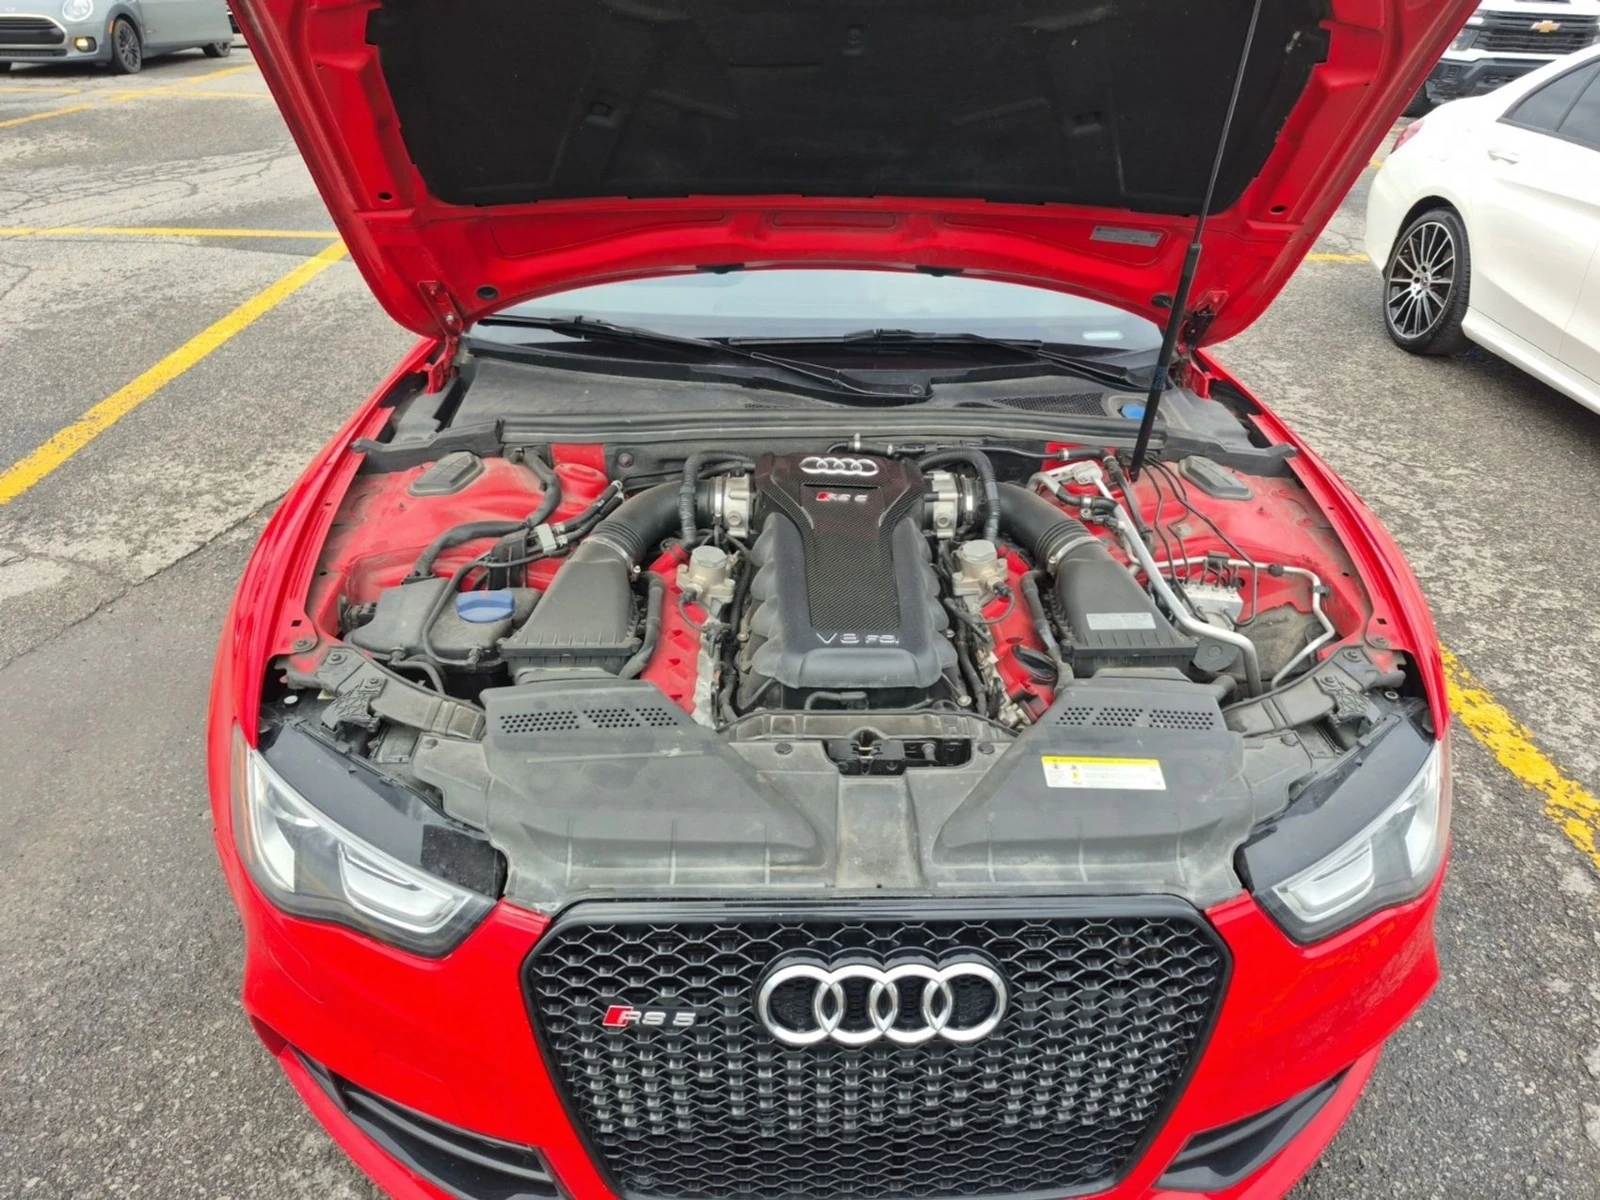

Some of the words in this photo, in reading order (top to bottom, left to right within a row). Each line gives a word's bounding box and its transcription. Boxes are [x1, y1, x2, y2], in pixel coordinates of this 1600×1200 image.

[816, 632, 859, 644] V8
[603, 1006, 666, 1025] RS
[672, 1012, 696, 1026] 5
